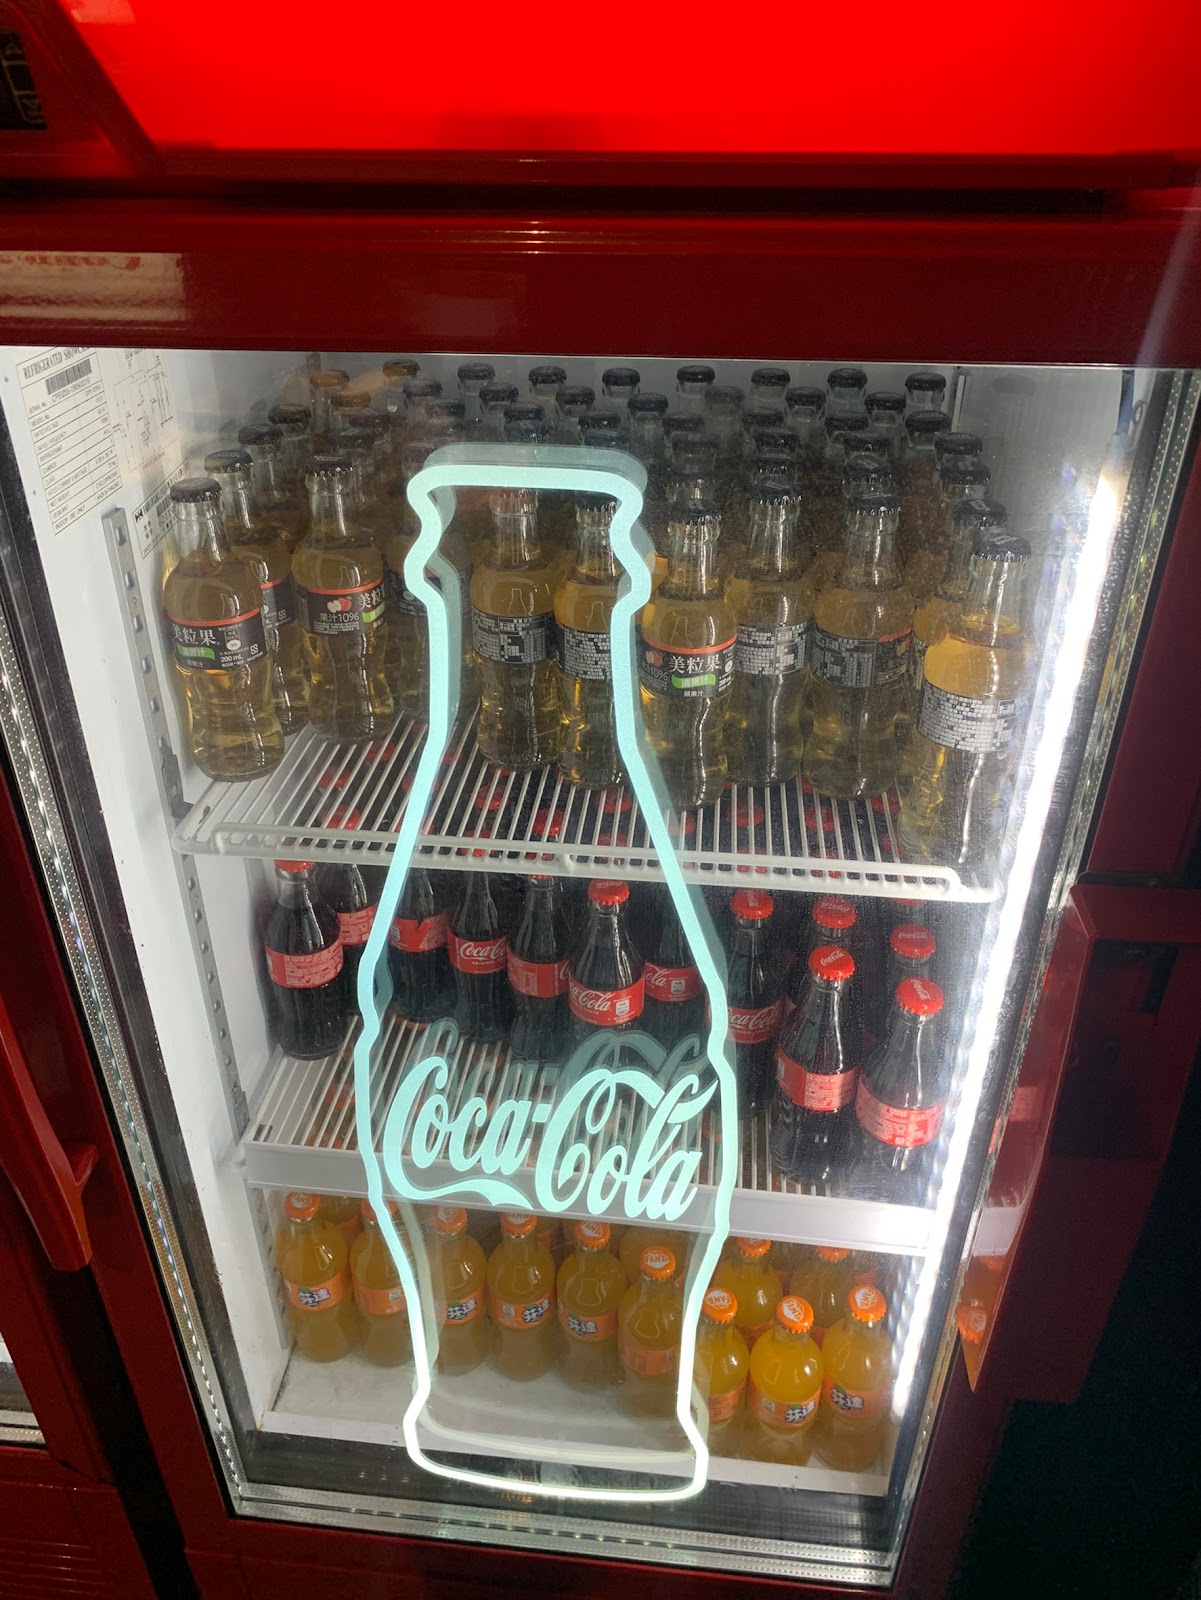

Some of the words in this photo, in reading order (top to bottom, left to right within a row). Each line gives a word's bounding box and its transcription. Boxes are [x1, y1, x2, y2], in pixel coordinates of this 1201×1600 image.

[23, 351, 62, 379] REFRIGERATED
[63, 348, 90, 360] SHOWC
[28, 403, 40, 414] SERIAL
[31, 415, 43, 427] MODEL
[39, 444, 62, 462] REFRIGERANT
[42, 461, 56, 474] CHARGE
[45, 475, 55, 486] CLASS
[95, 469, 117, 489] CYCLOPENTANE
[57, 490, 70, 502] WEIGHT
[55, 516, 68, 530] INDOOR
[68, 510, 76, 520] USE
[76, 504, 85, 515] ONLY
[320, 612, 360, 623] 果汁10%
[172, 623, 217, 646] 美粒果
[221, 655, 233, 663] 200
[233, 653, 244, 661] mL
[669, 654, 720, 674] 美粒果
[820, 950, 845, 966] Coca-Cola
[383, 1056, 719, 1222] Coca-Cola
[646, 1254, 669, 1263] FANTA
